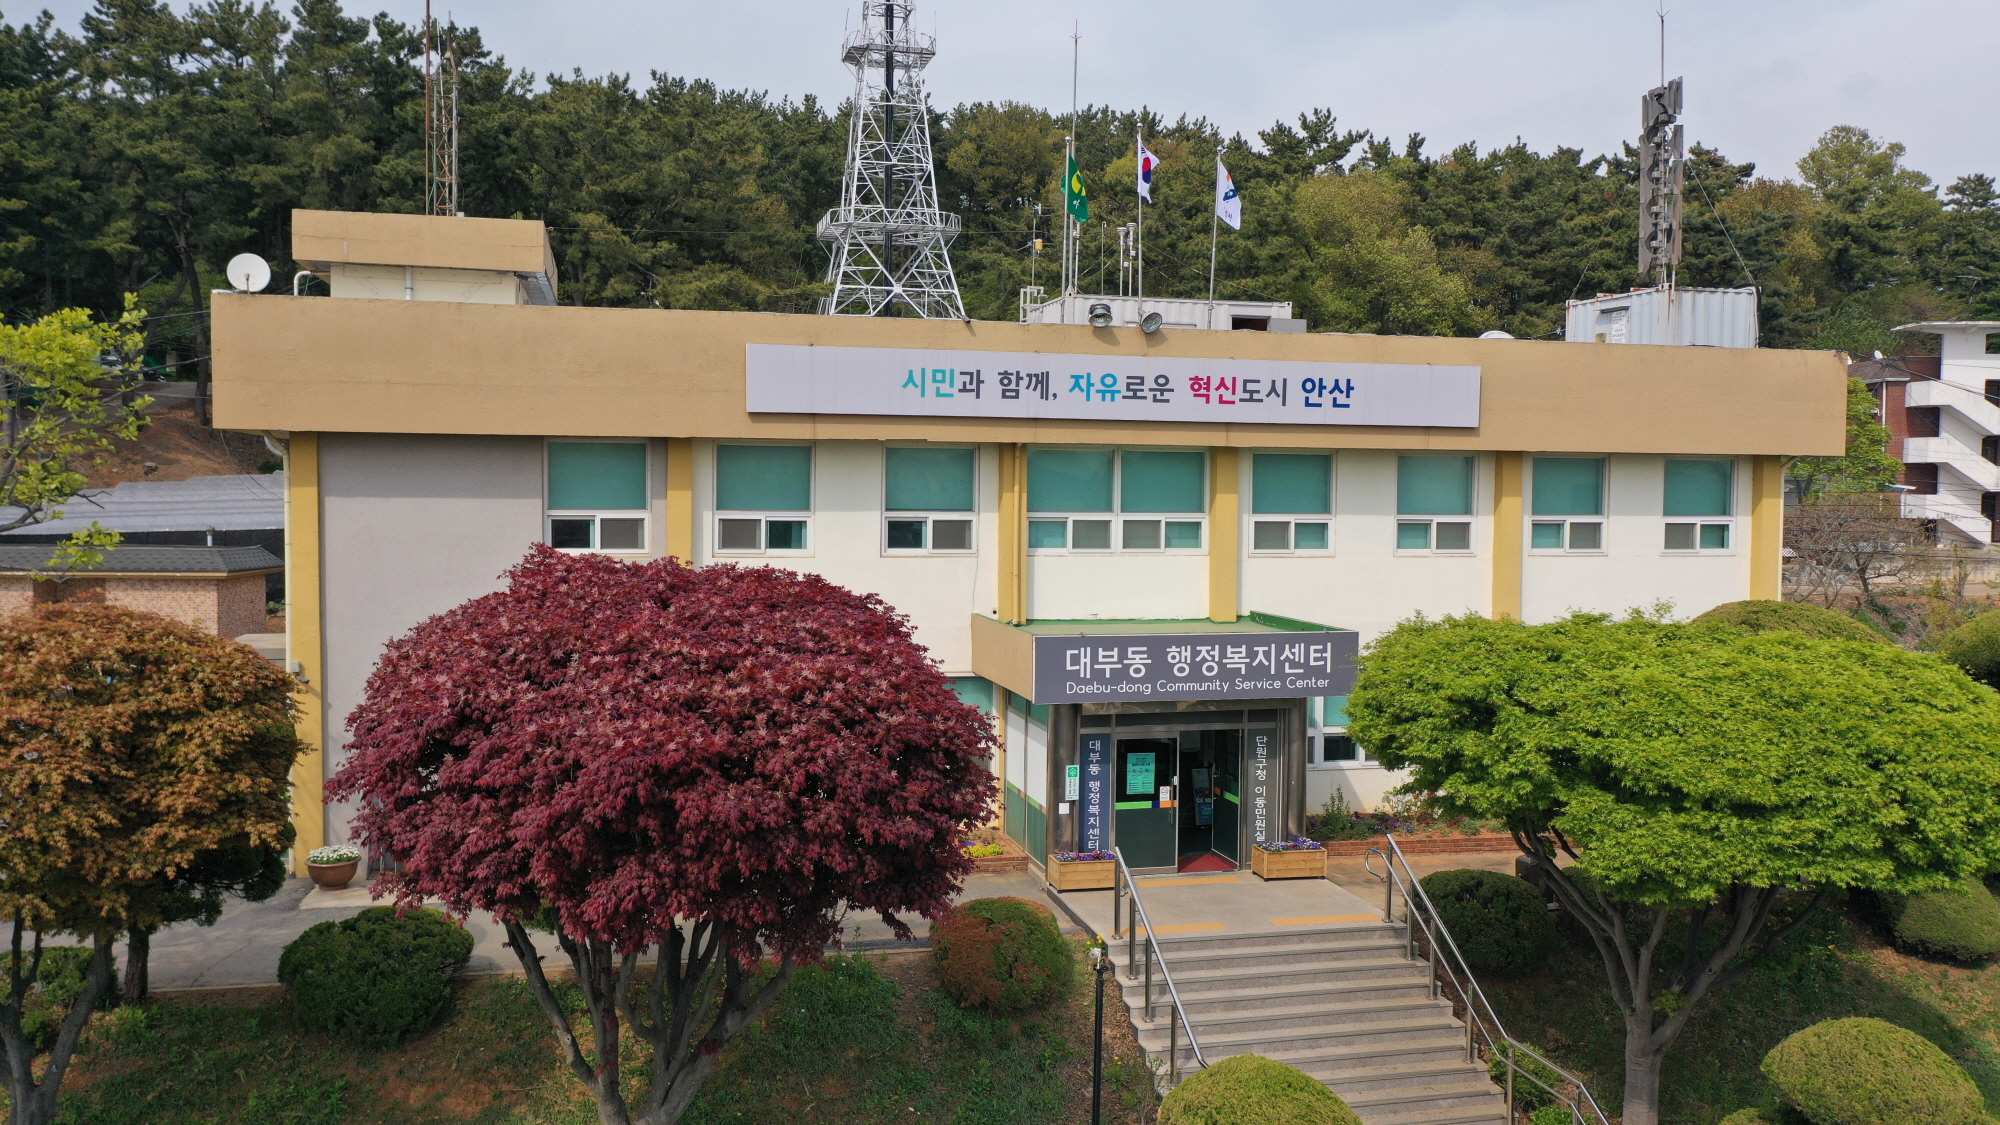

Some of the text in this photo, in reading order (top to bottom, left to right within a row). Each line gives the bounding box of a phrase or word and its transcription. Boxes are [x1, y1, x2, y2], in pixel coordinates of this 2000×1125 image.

[901, 367, 1355, 408] 시민과 함께, 자유로운 혁신도시 안산
[1066, 642, 1332, 679] 대부동 행정복지센터
[1066, 676, 1330, 695] Daebu-dong Community Service Center
[1087, 739, 1101, 852] 대부동 행정복지센터
[1254, 735, 1268, 842] 단원구청 이동민원실
